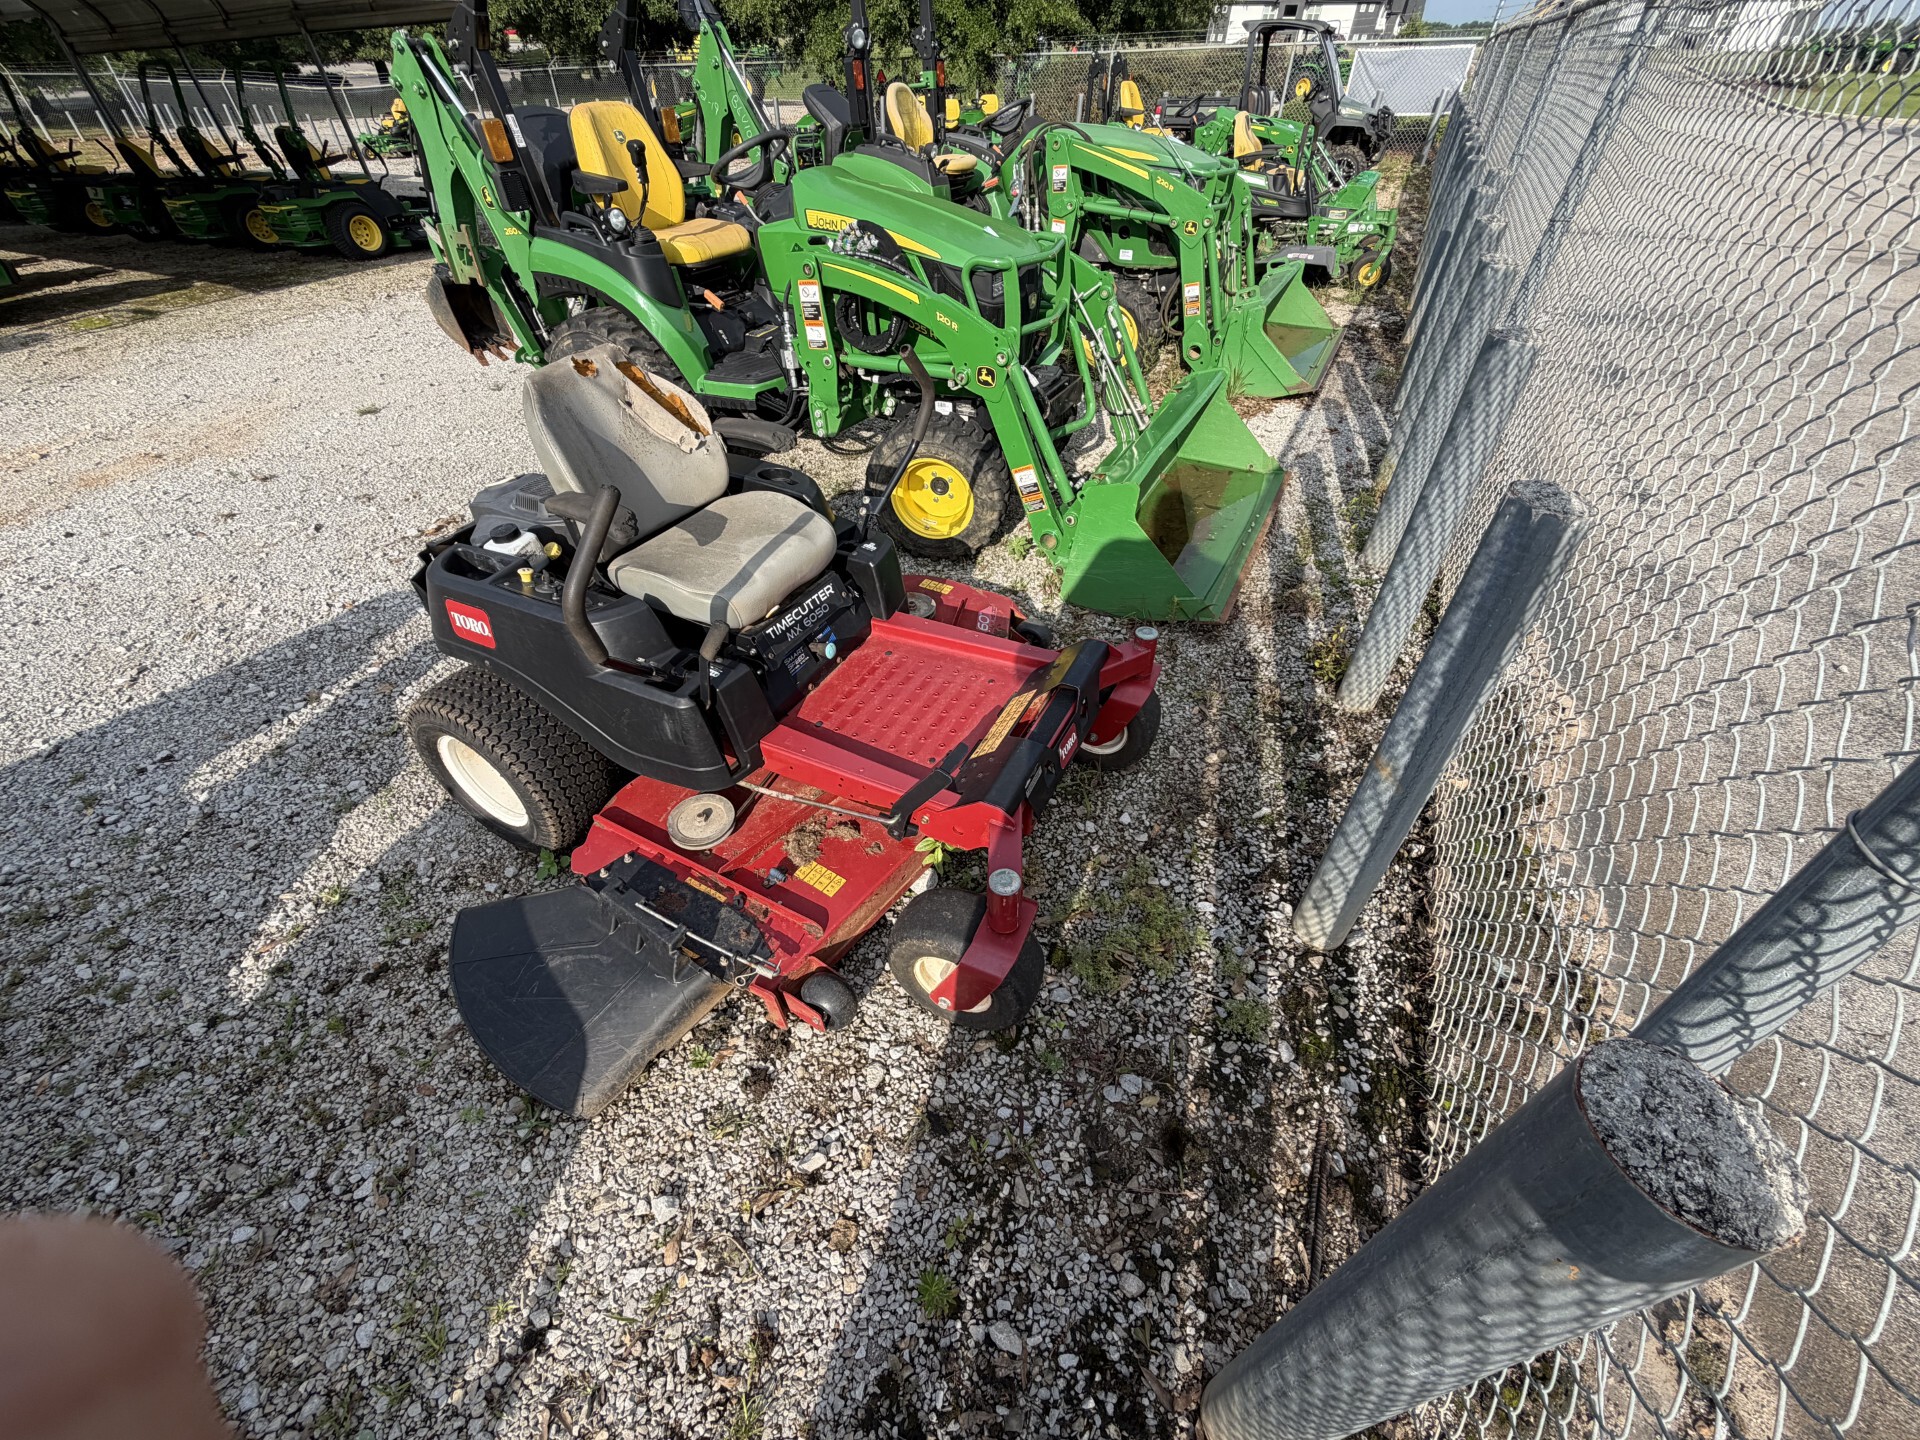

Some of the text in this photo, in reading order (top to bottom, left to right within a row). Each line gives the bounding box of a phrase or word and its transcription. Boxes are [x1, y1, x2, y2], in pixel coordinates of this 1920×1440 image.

[812, 215, 838, 229] JOHN
[935, 311, 959, 332] 120 R
[765, 583, 835, 639] TIMECUTTER
[786, 624, 803, 642] MX
[802, 603, 830, 627] 6050
[450, 611, 489, 636] TORO
[783, 645, 804, 666] SMART
[787, 653, 806, 671] SPEED
[1058, 732, 1077, 760] TORO
